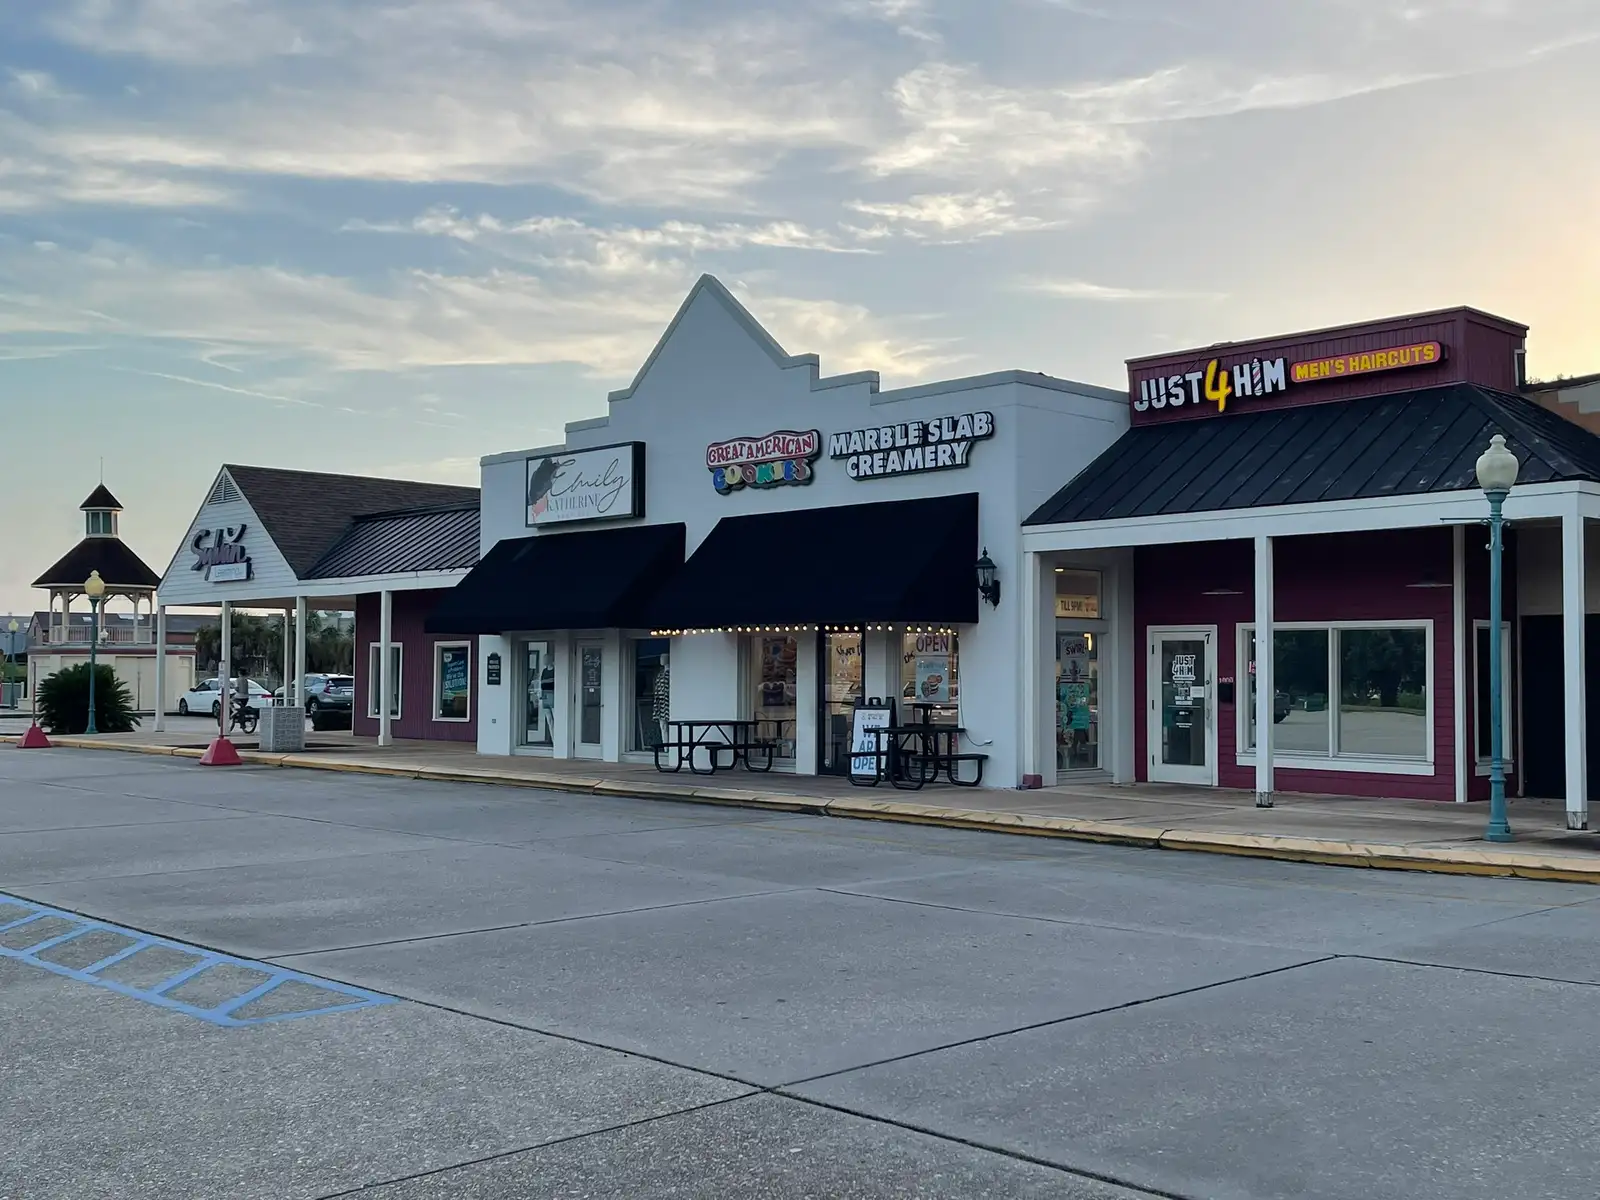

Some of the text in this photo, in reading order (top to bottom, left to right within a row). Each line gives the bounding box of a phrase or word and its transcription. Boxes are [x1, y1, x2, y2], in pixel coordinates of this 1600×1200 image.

[1295, 344, 1436, 380] MEN'S HAIRCUTS
[1134, 358, 1286, 413] JUST 4 HIM
[708, 433, 813, 463] GREAT AMERICAN
[828, 411, 994, 456] MARBLE SLAB
[712, 459, 810, 490] COOKIES
[846, 440, 970, 479] CREAMERY
[550, 458, 630, 514] Emily
[546, 493, 601, 512] KATHERINE
[916, 635, 949, 652] OPEN
[1205, 634, 1211, 645] 7
[1175, 654, 1196, 665] JUST
[853, 757, 875, 770] OPE
